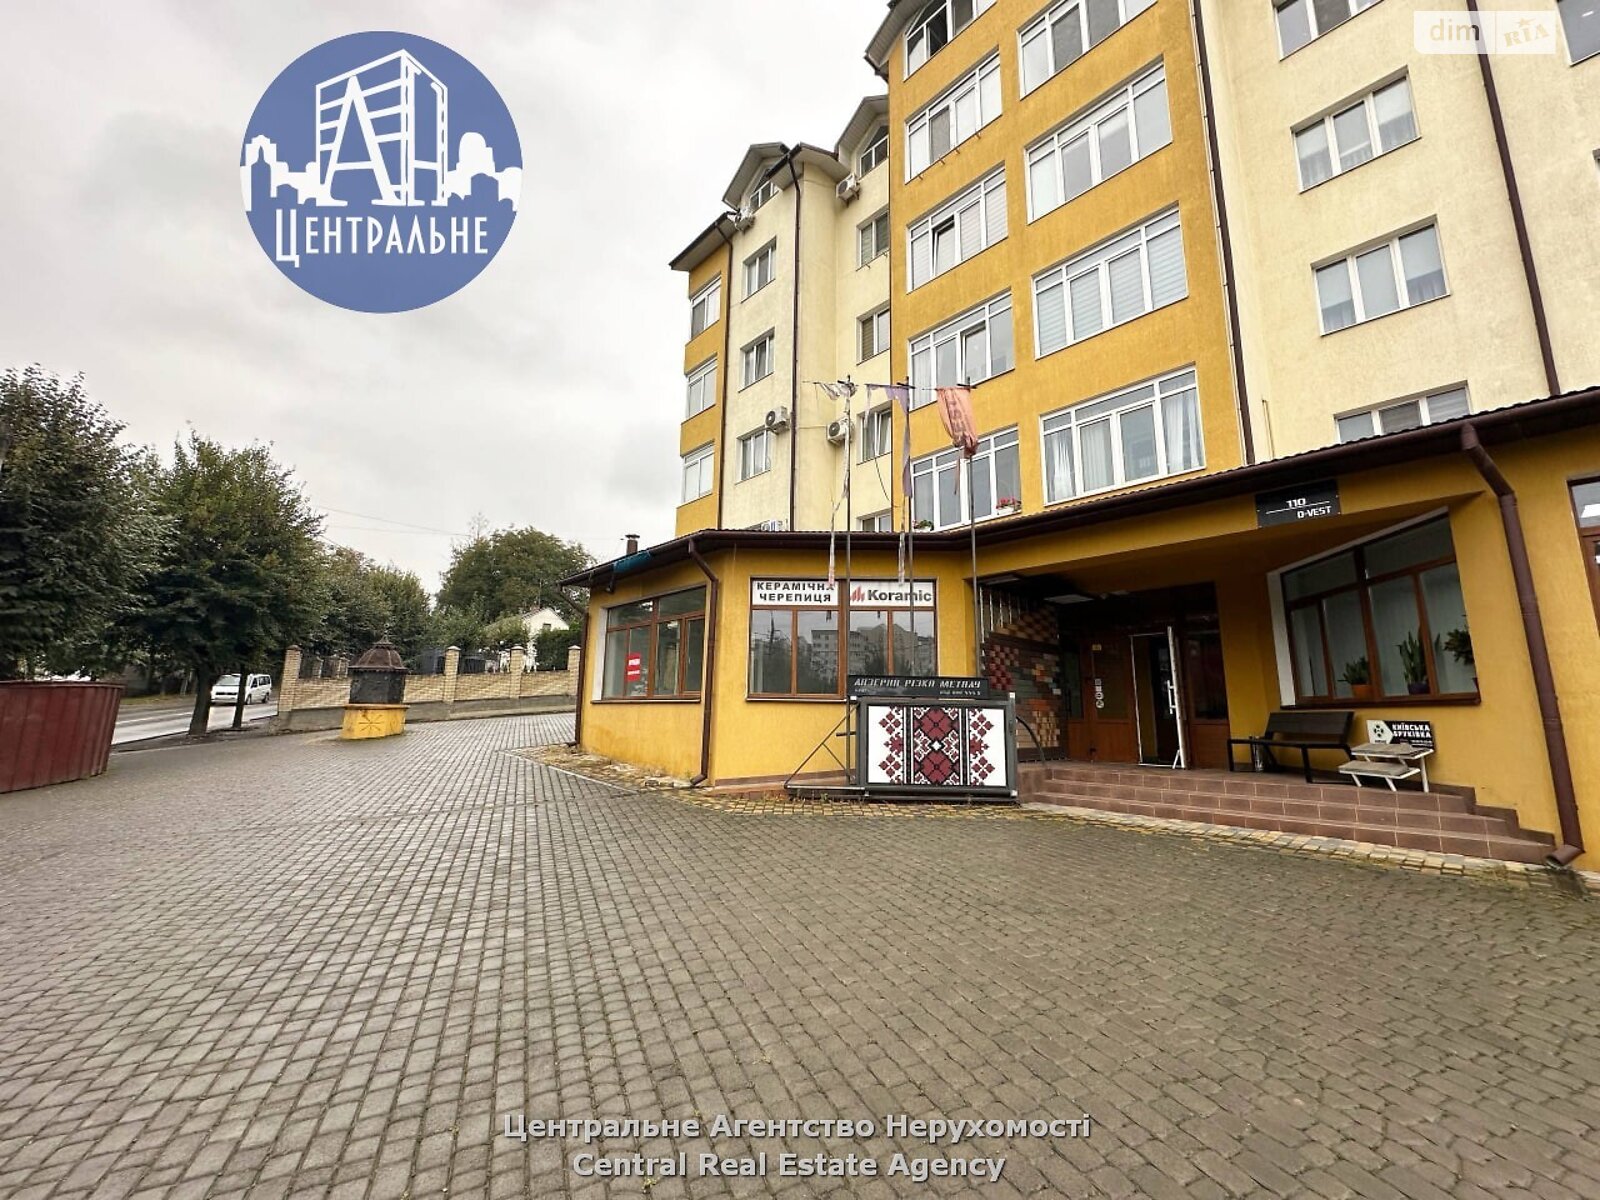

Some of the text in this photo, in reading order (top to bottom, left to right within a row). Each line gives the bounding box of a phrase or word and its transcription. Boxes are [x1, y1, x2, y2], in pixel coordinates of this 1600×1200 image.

[1297, 505, 1332, 519] D-VEST
[759, 593, 831, 604] ЧЕРЕПИЦЯ
[867, 589, 932, 602] Koramic
